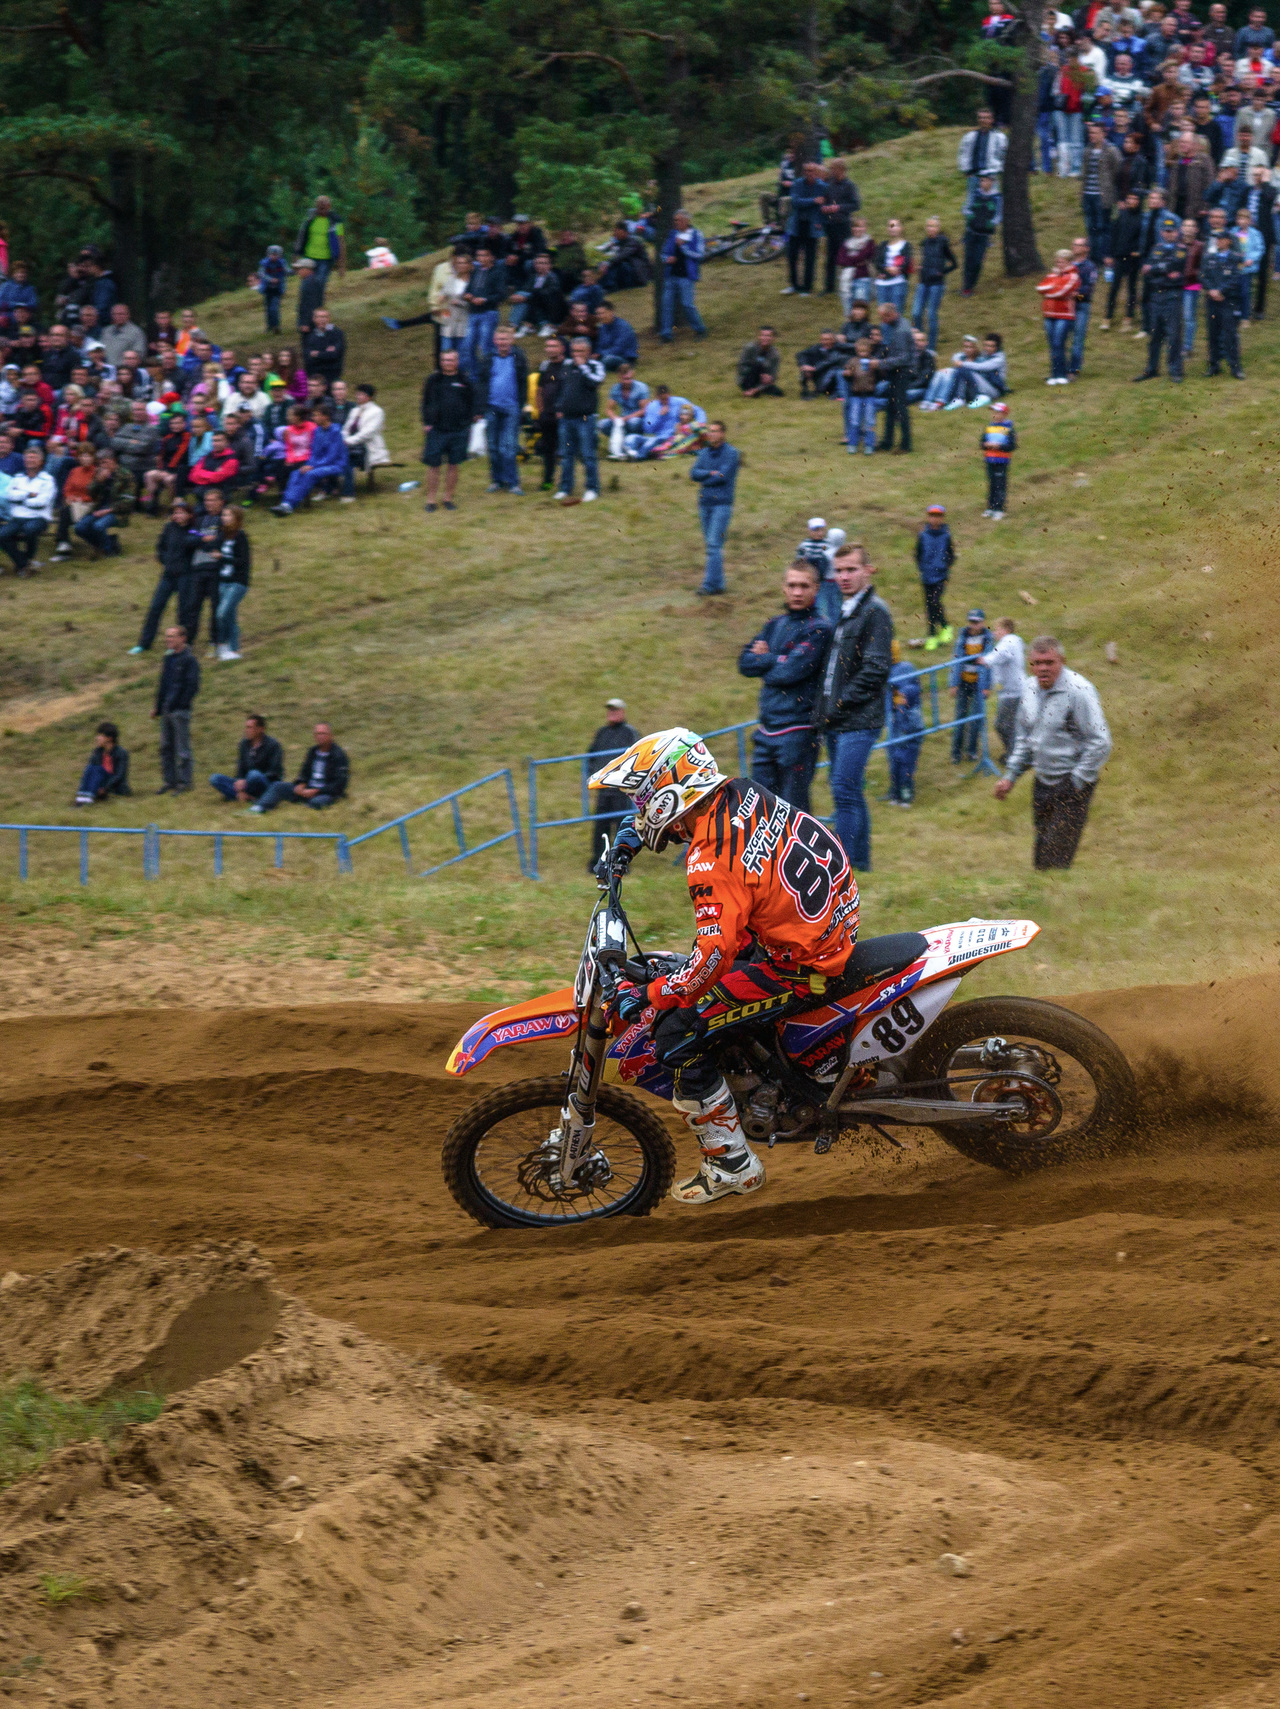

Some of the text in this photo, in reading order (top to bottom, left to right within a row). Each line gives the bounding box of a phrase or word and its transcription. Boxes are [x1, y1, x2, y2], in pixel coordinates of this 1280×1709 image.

[742, 819, 769, 865] EVGENI
[747, 800, 790, 875] TYLETS
[687, 862, 715, 875] RAW
[780, 812, 848, 921] 89
[948, 941, 1012, 966] BRIDGESTONE
[490, 1016, 553, 1043] YARAW
[708, 990, 794, 1031] SCOTT
[871, 996, 925, 1053] 89
[614, 1018, 648, 1054] YARAW
